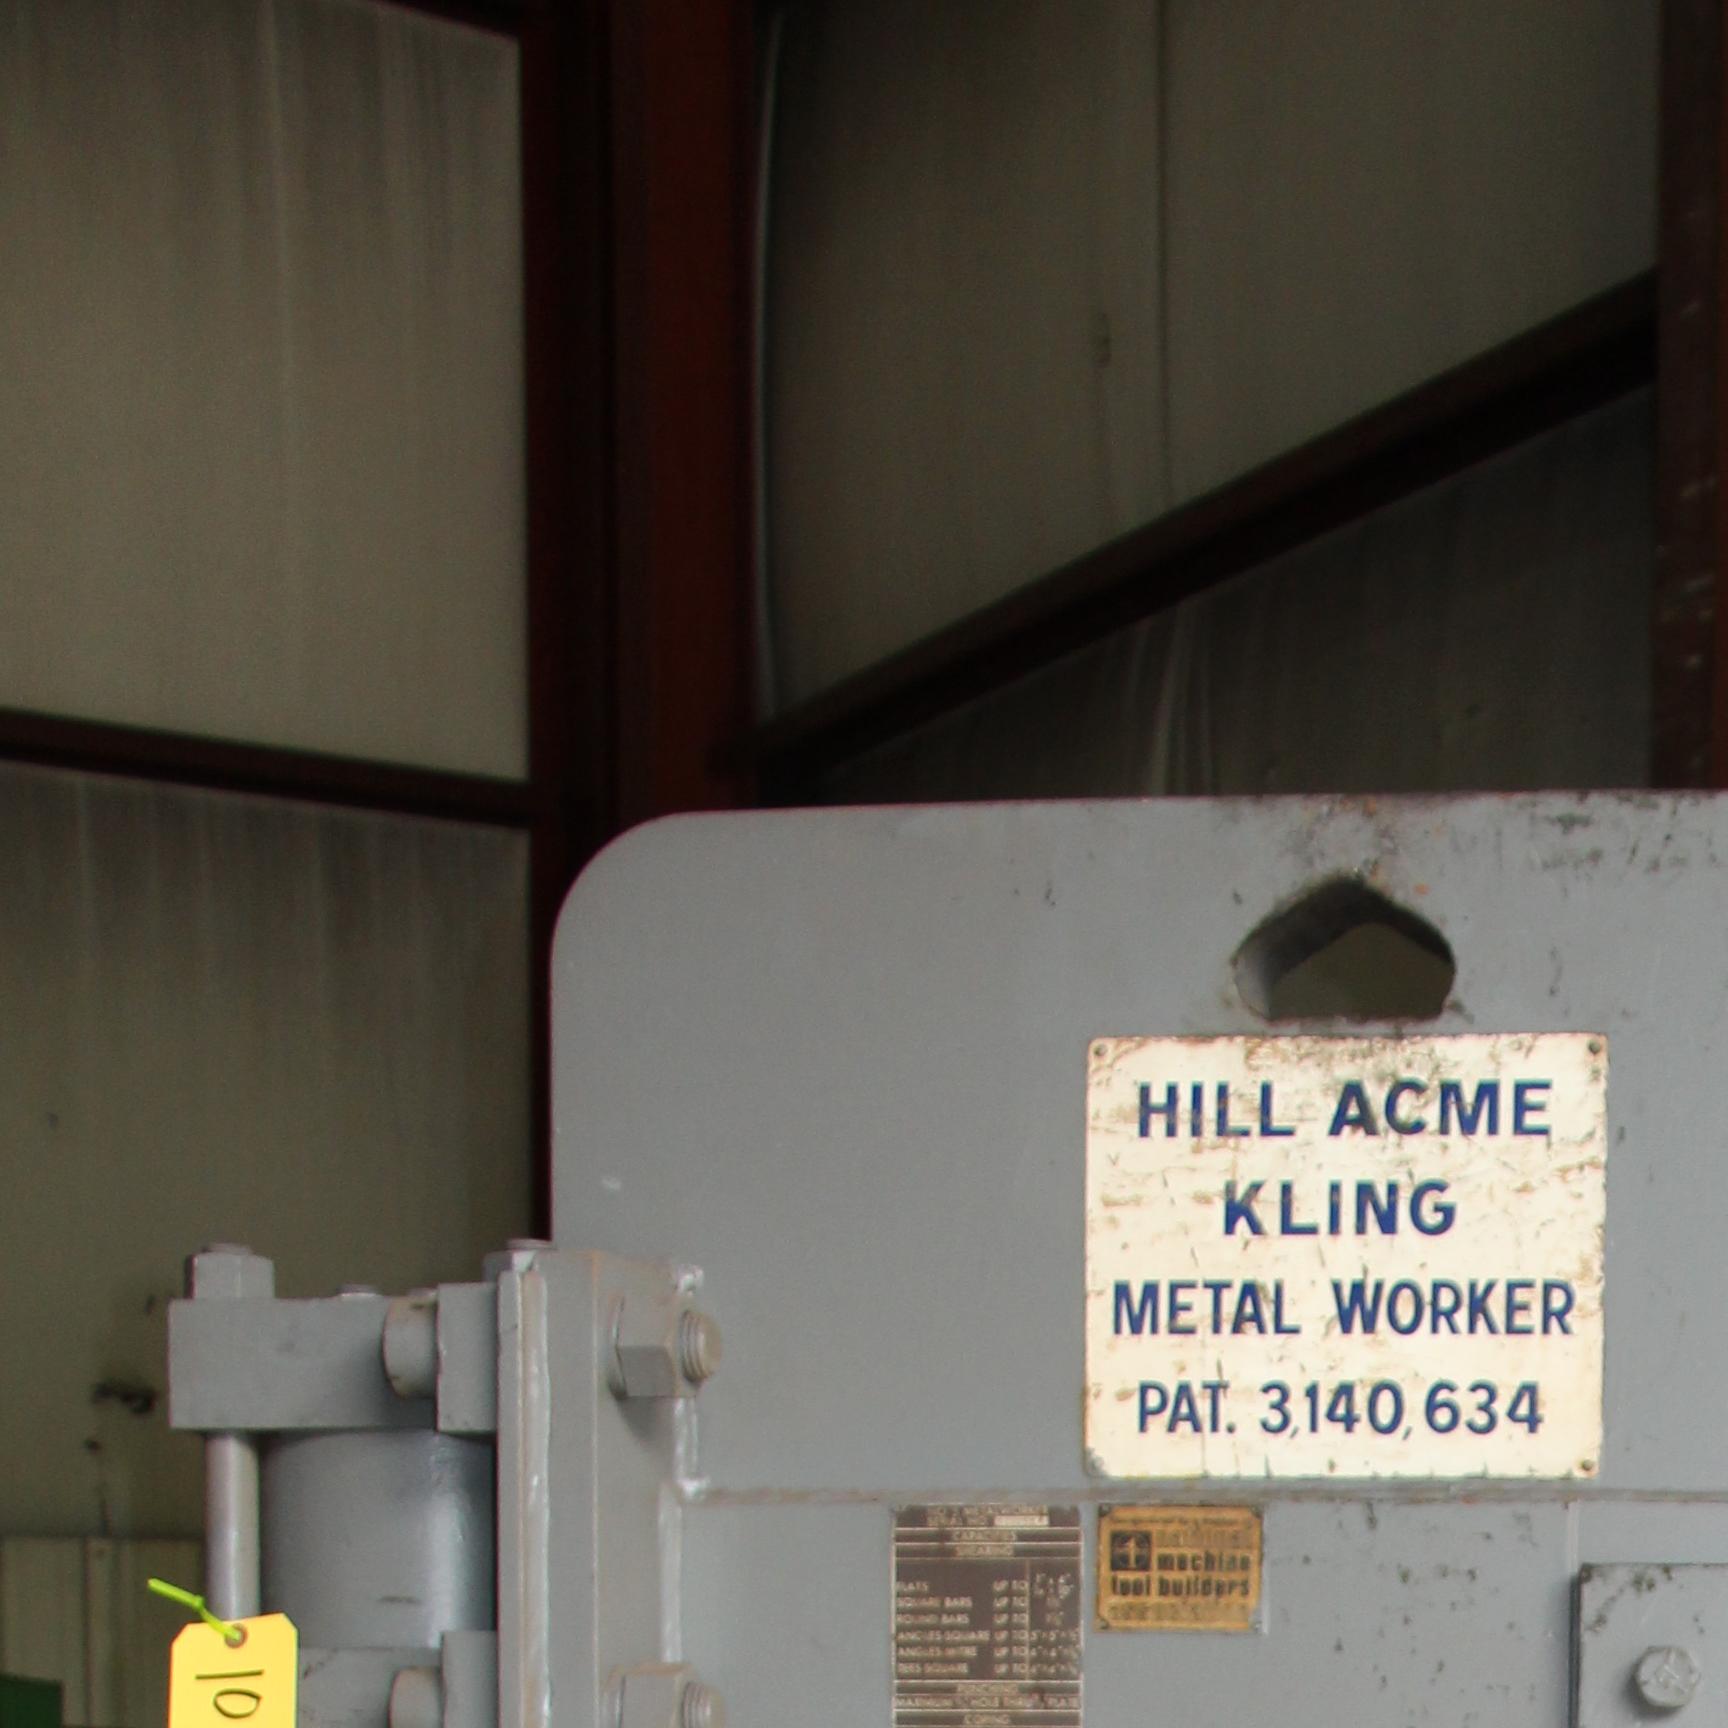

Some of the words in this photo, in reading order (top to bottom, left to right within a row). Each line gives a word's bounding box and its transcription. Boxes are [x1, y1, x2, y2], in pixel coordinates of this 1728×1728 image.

[1137, 1080, 1296, 1137] HILL
[1328, 1078, 1553, 1137] ACME
[1222, 1179, 1457, 1236] KLING
[1112, 1279, 1301, 1335] METAL
[1331, 1279, 1576, 1335] WORKER
[1137, 1380, 1237, 1434] PAT.
[1259, 1380, 1544, 1440] 3,140,634
[1112, 1575, 1150, 1595] tool
[1158, 1575, 1249, 1597] builders
